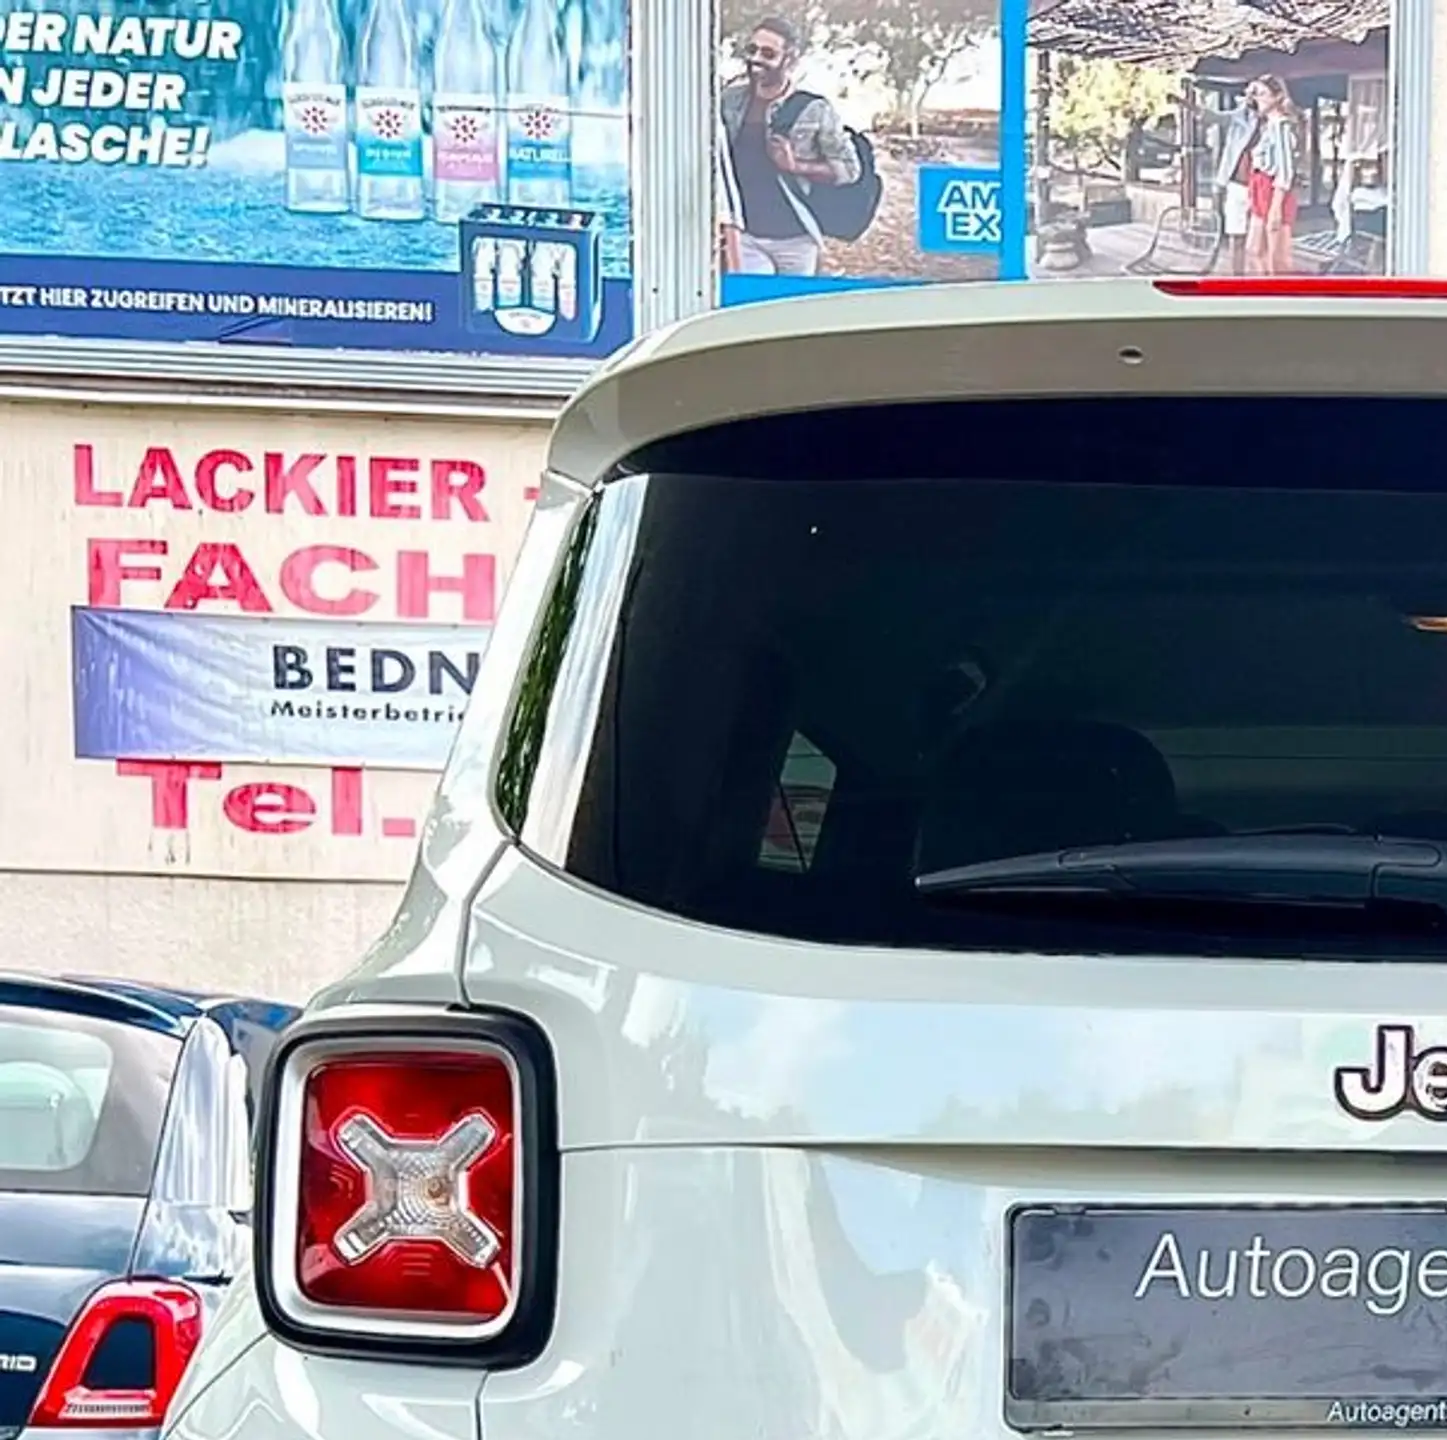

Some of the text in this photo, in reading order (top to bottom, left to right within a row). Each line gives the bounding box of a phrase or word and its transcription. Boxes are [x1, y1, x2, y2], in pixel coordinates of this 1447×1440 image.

[0, 12, 242, 60] ER NATUR
[31, 68, 186, 111] JEDER
[0, 121, 211, 167] LASCHE!
[948, 211, 1001, 240] EX
[0, 286, 432, 322] TZT HIER ZUGREIFEN UND MINERALISIEREN!
[74, 443, 491, 522] LACKIER
[88, 538, 496, 621] FACH
[273, 644, 479, 695] BEDN
[116, 758, 415, 837] Tel.
